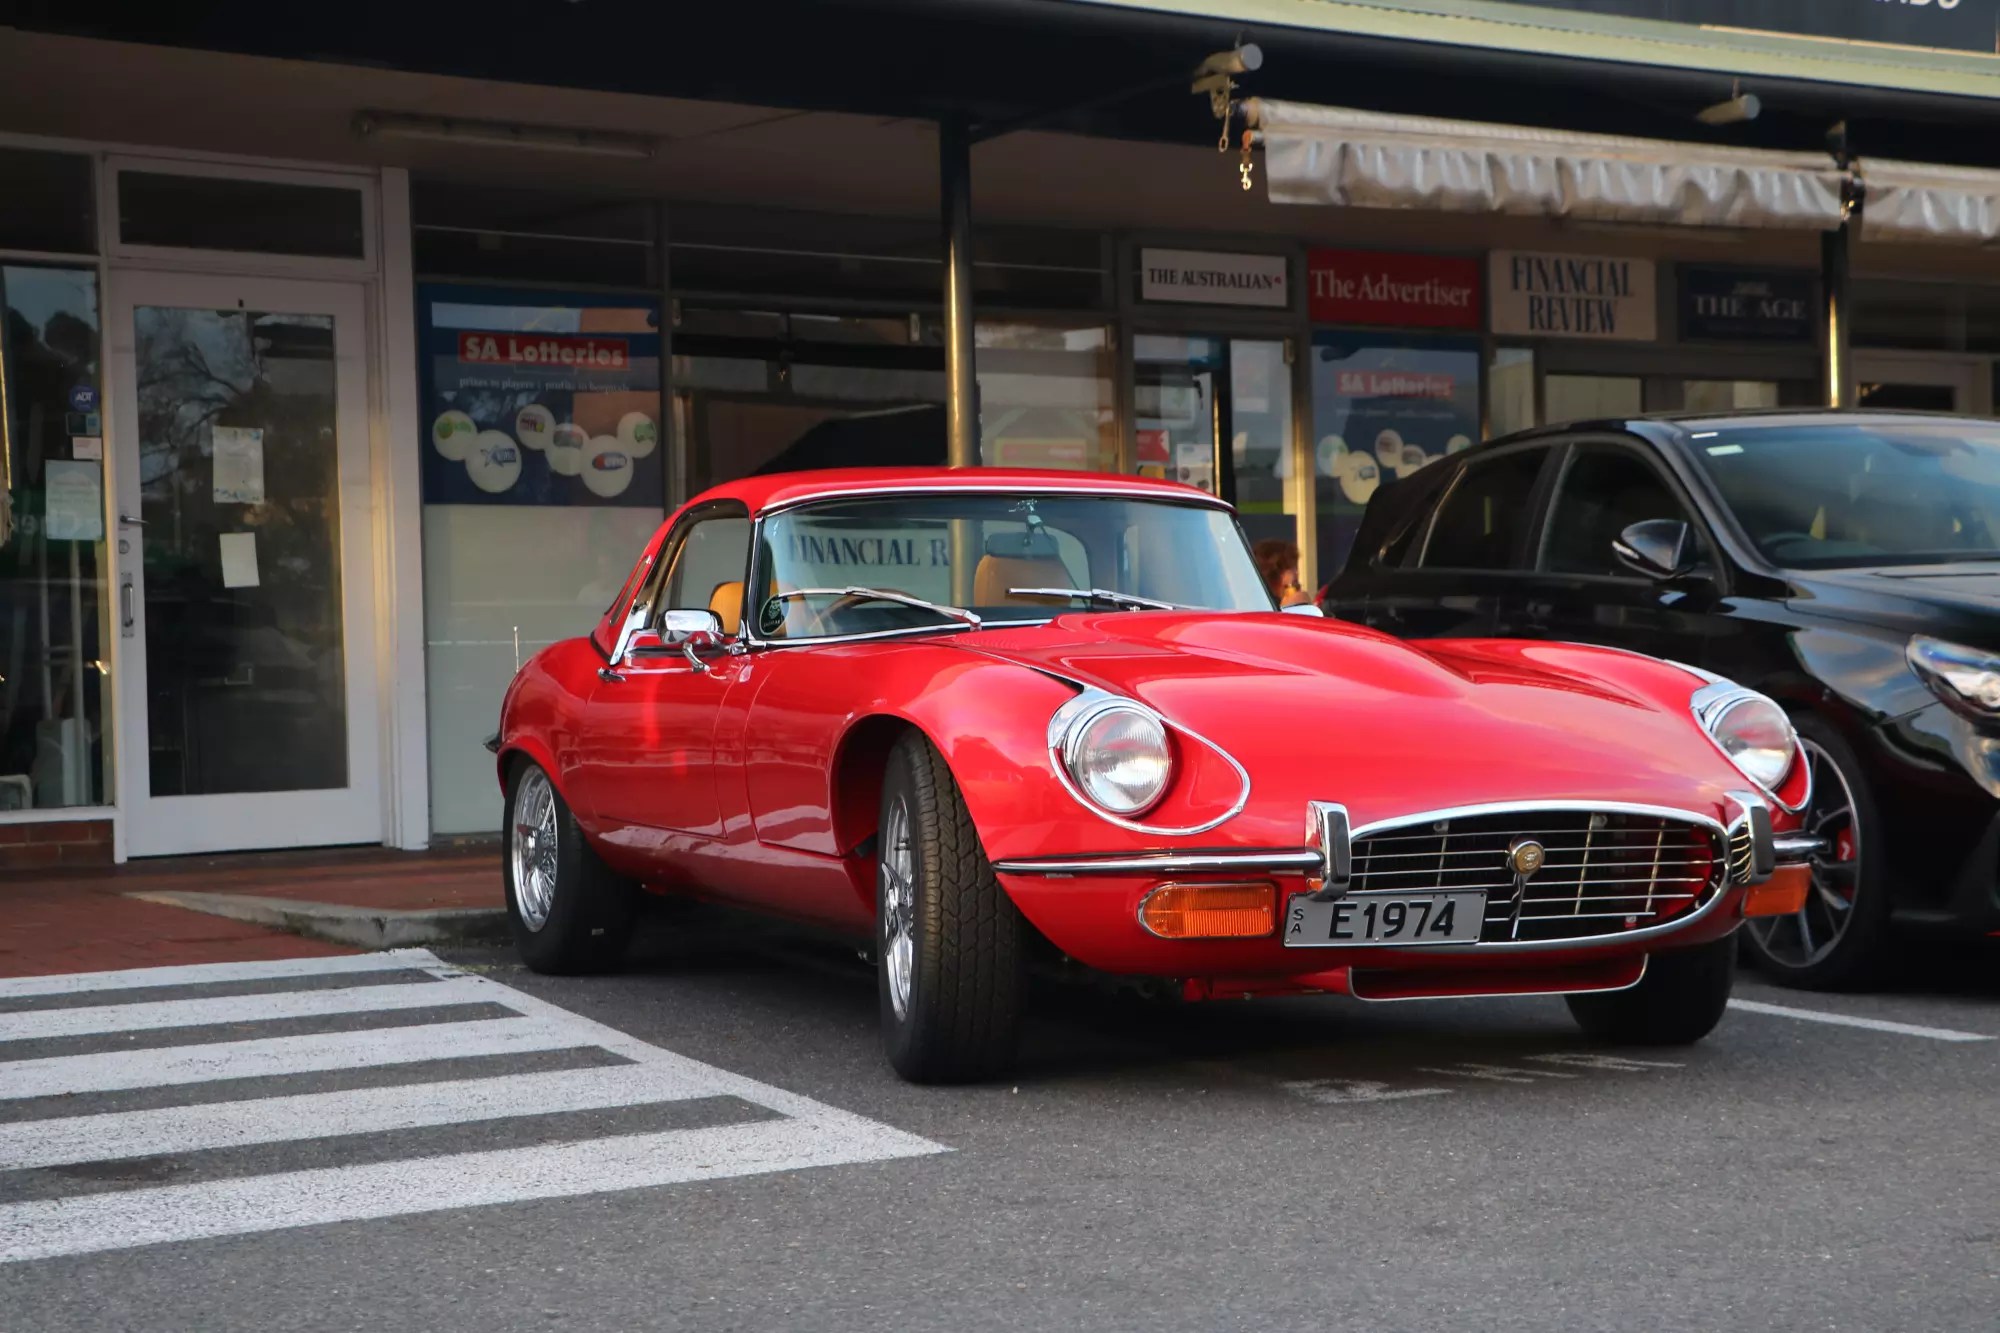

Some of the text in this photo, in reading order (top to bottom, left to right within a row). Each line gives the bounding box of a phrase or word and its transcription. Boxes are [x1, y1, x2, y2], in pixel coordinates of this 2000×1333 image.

[1149, 268, 1274, 289] THE AUSTRALIAN
[1310, 269, 1472, 307] The Advertiser
[1511, 255, 1634, 297] FINANCIAL
[1529, 295, 1621, 334] REVIEW
[1692, 295, 1806, 320] THE AGE
[465, 336, 624, 366] SA Lotteries
[76, 391, 93, 402] ADT
[1340, 373, 1450, 396] SA Lotteries
[788, 533, 921, 566] FINANCIAL
[1329, 899, 1456, 939] E1974
